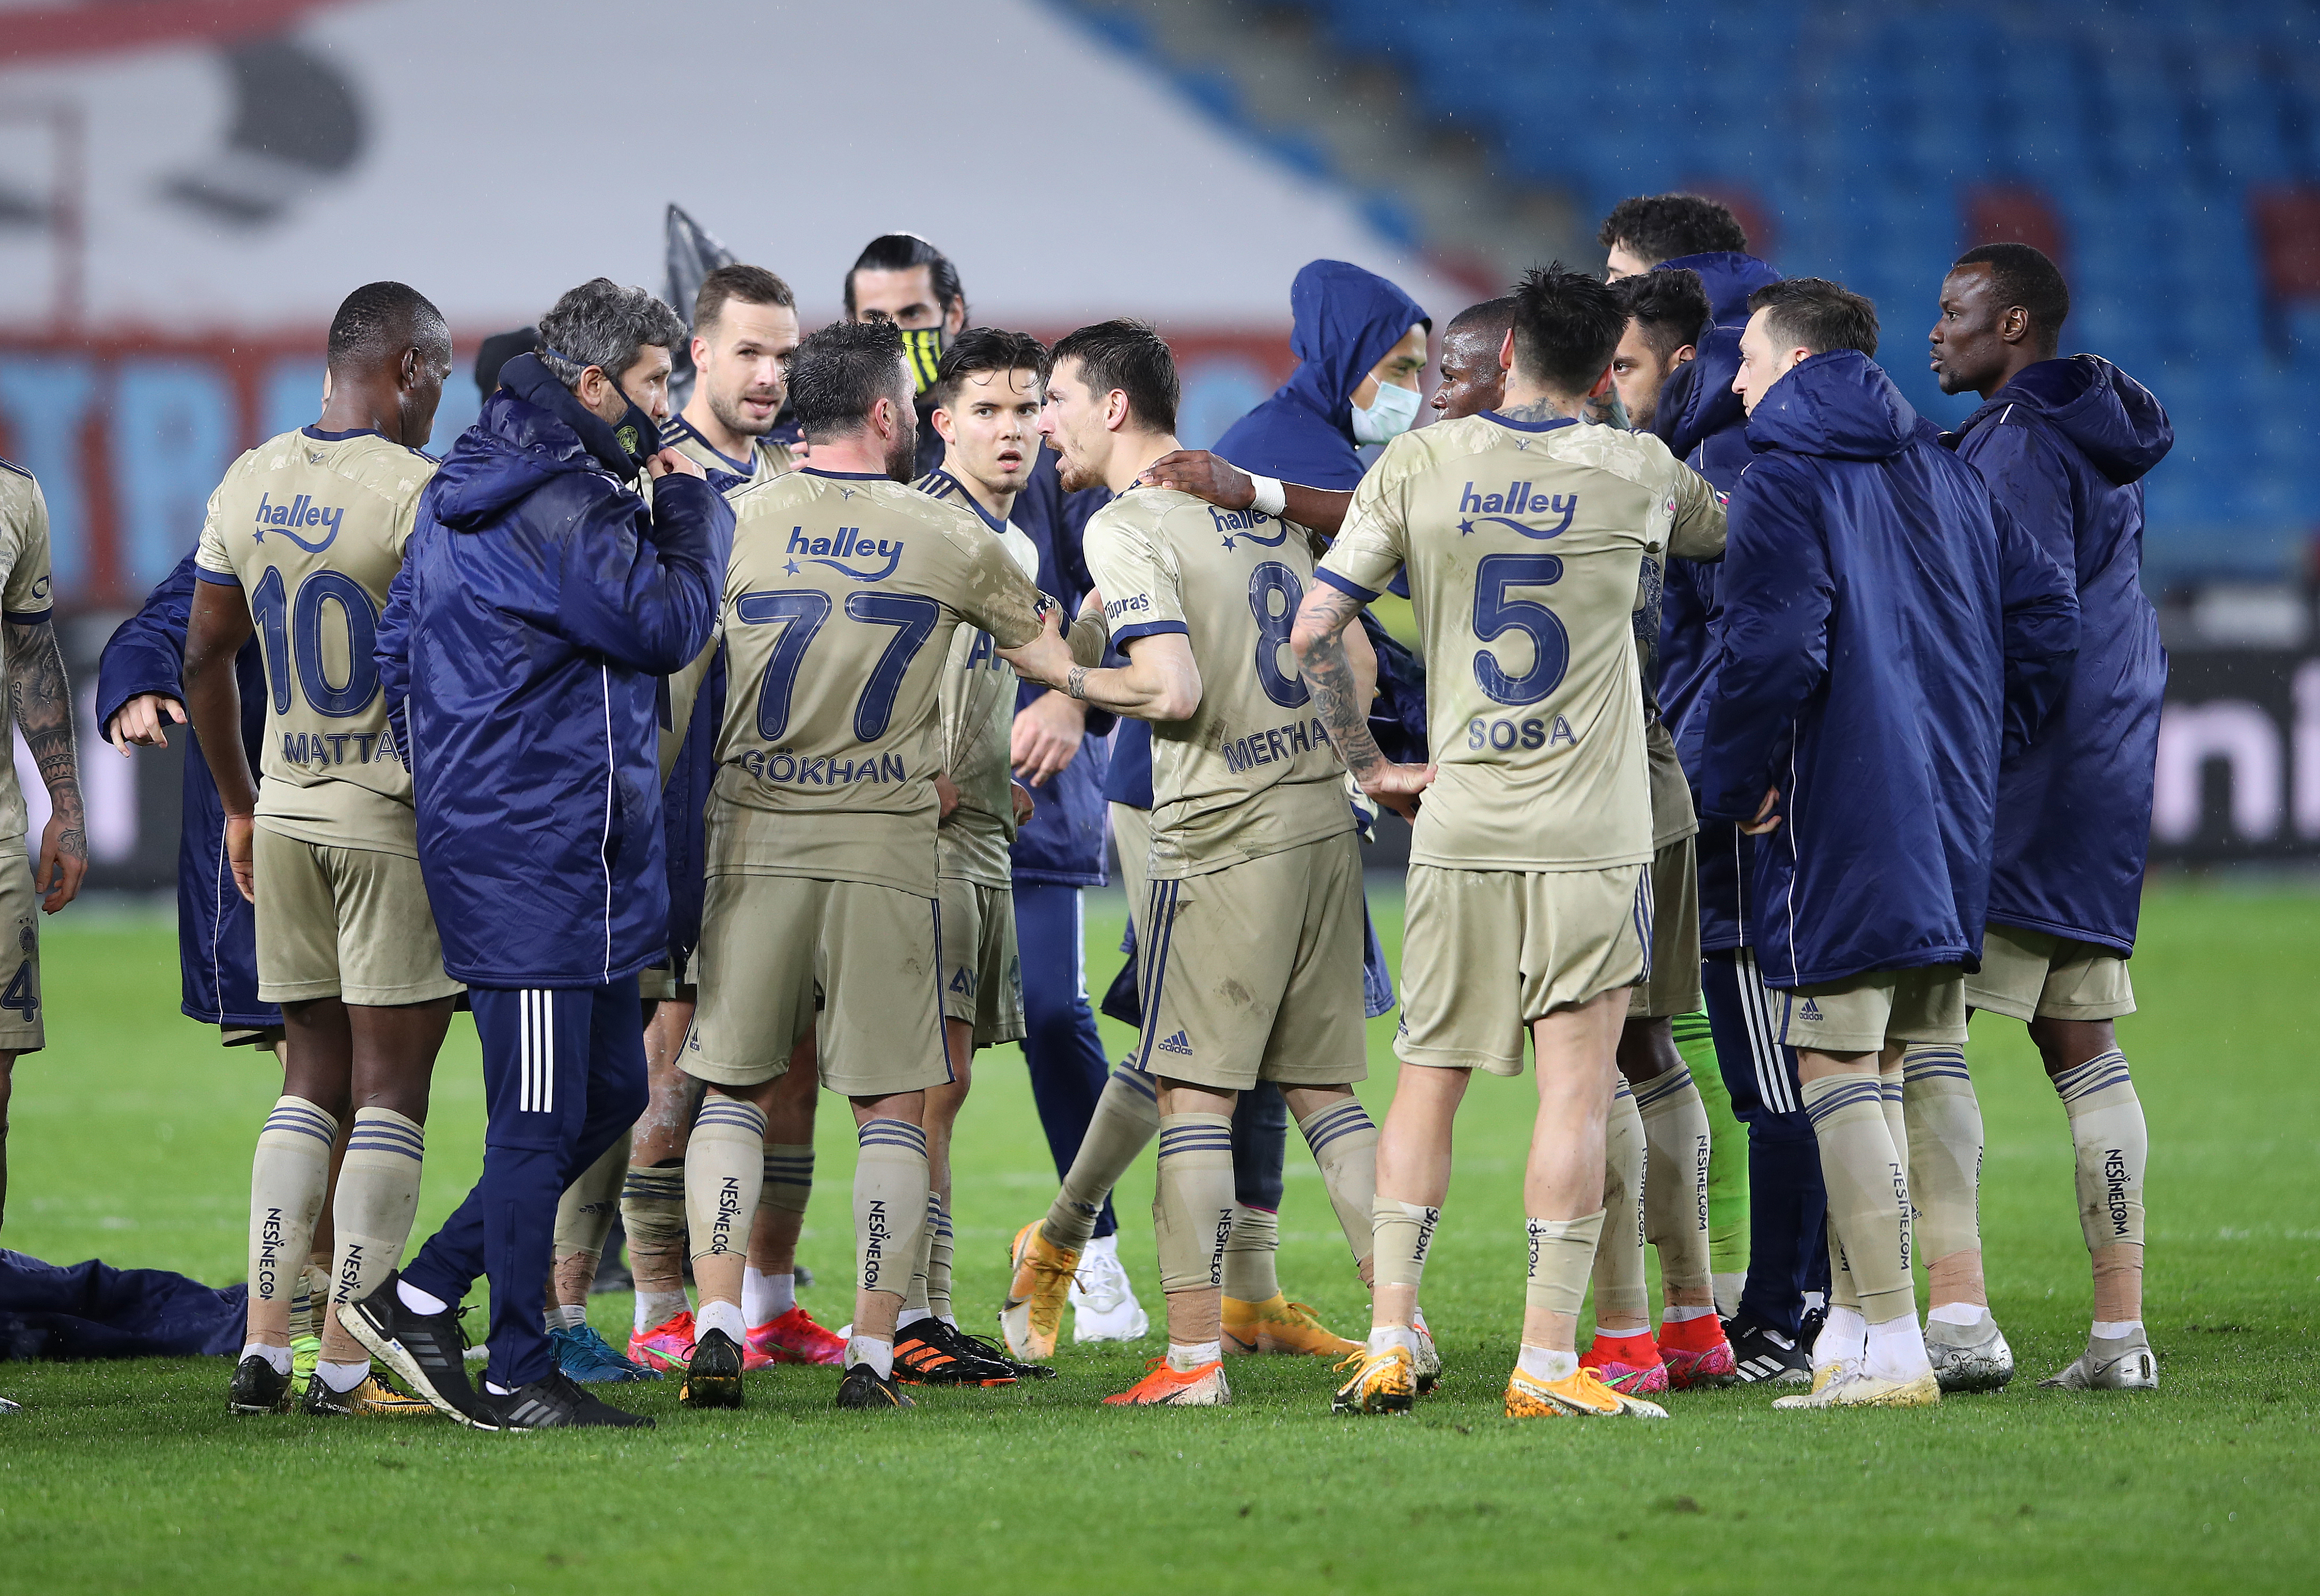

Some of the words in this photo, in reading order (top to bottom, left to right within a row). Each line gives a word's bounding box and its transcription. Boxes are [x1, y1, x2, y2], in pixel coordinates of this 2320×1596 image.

[255, 492, 344, 553] halley
[1458, 481, 1577, 539] halley
[785, 526, 904, 582] halley
[252, 565, 383, 718] 10
[1249, 561, 1311, 709] 8
[1473, 553, 1570, 706] 5
[737, 589, 940, 743] 77
[284, 730, 400, 764] MATTA
[1468, 714, 1577, 751] SOSA
[740, 747, 906, 786] GÖKHAN
[1, 960, 38, 1023] 4
[1798, 1012, 1823, 1021] adidas
[1158, 1042, 1193, 1056] adidas
[1696, 1135, 1709, 1231] NESINE.COM
[1888, 1162, 1910, 1270] NESINE.COM
